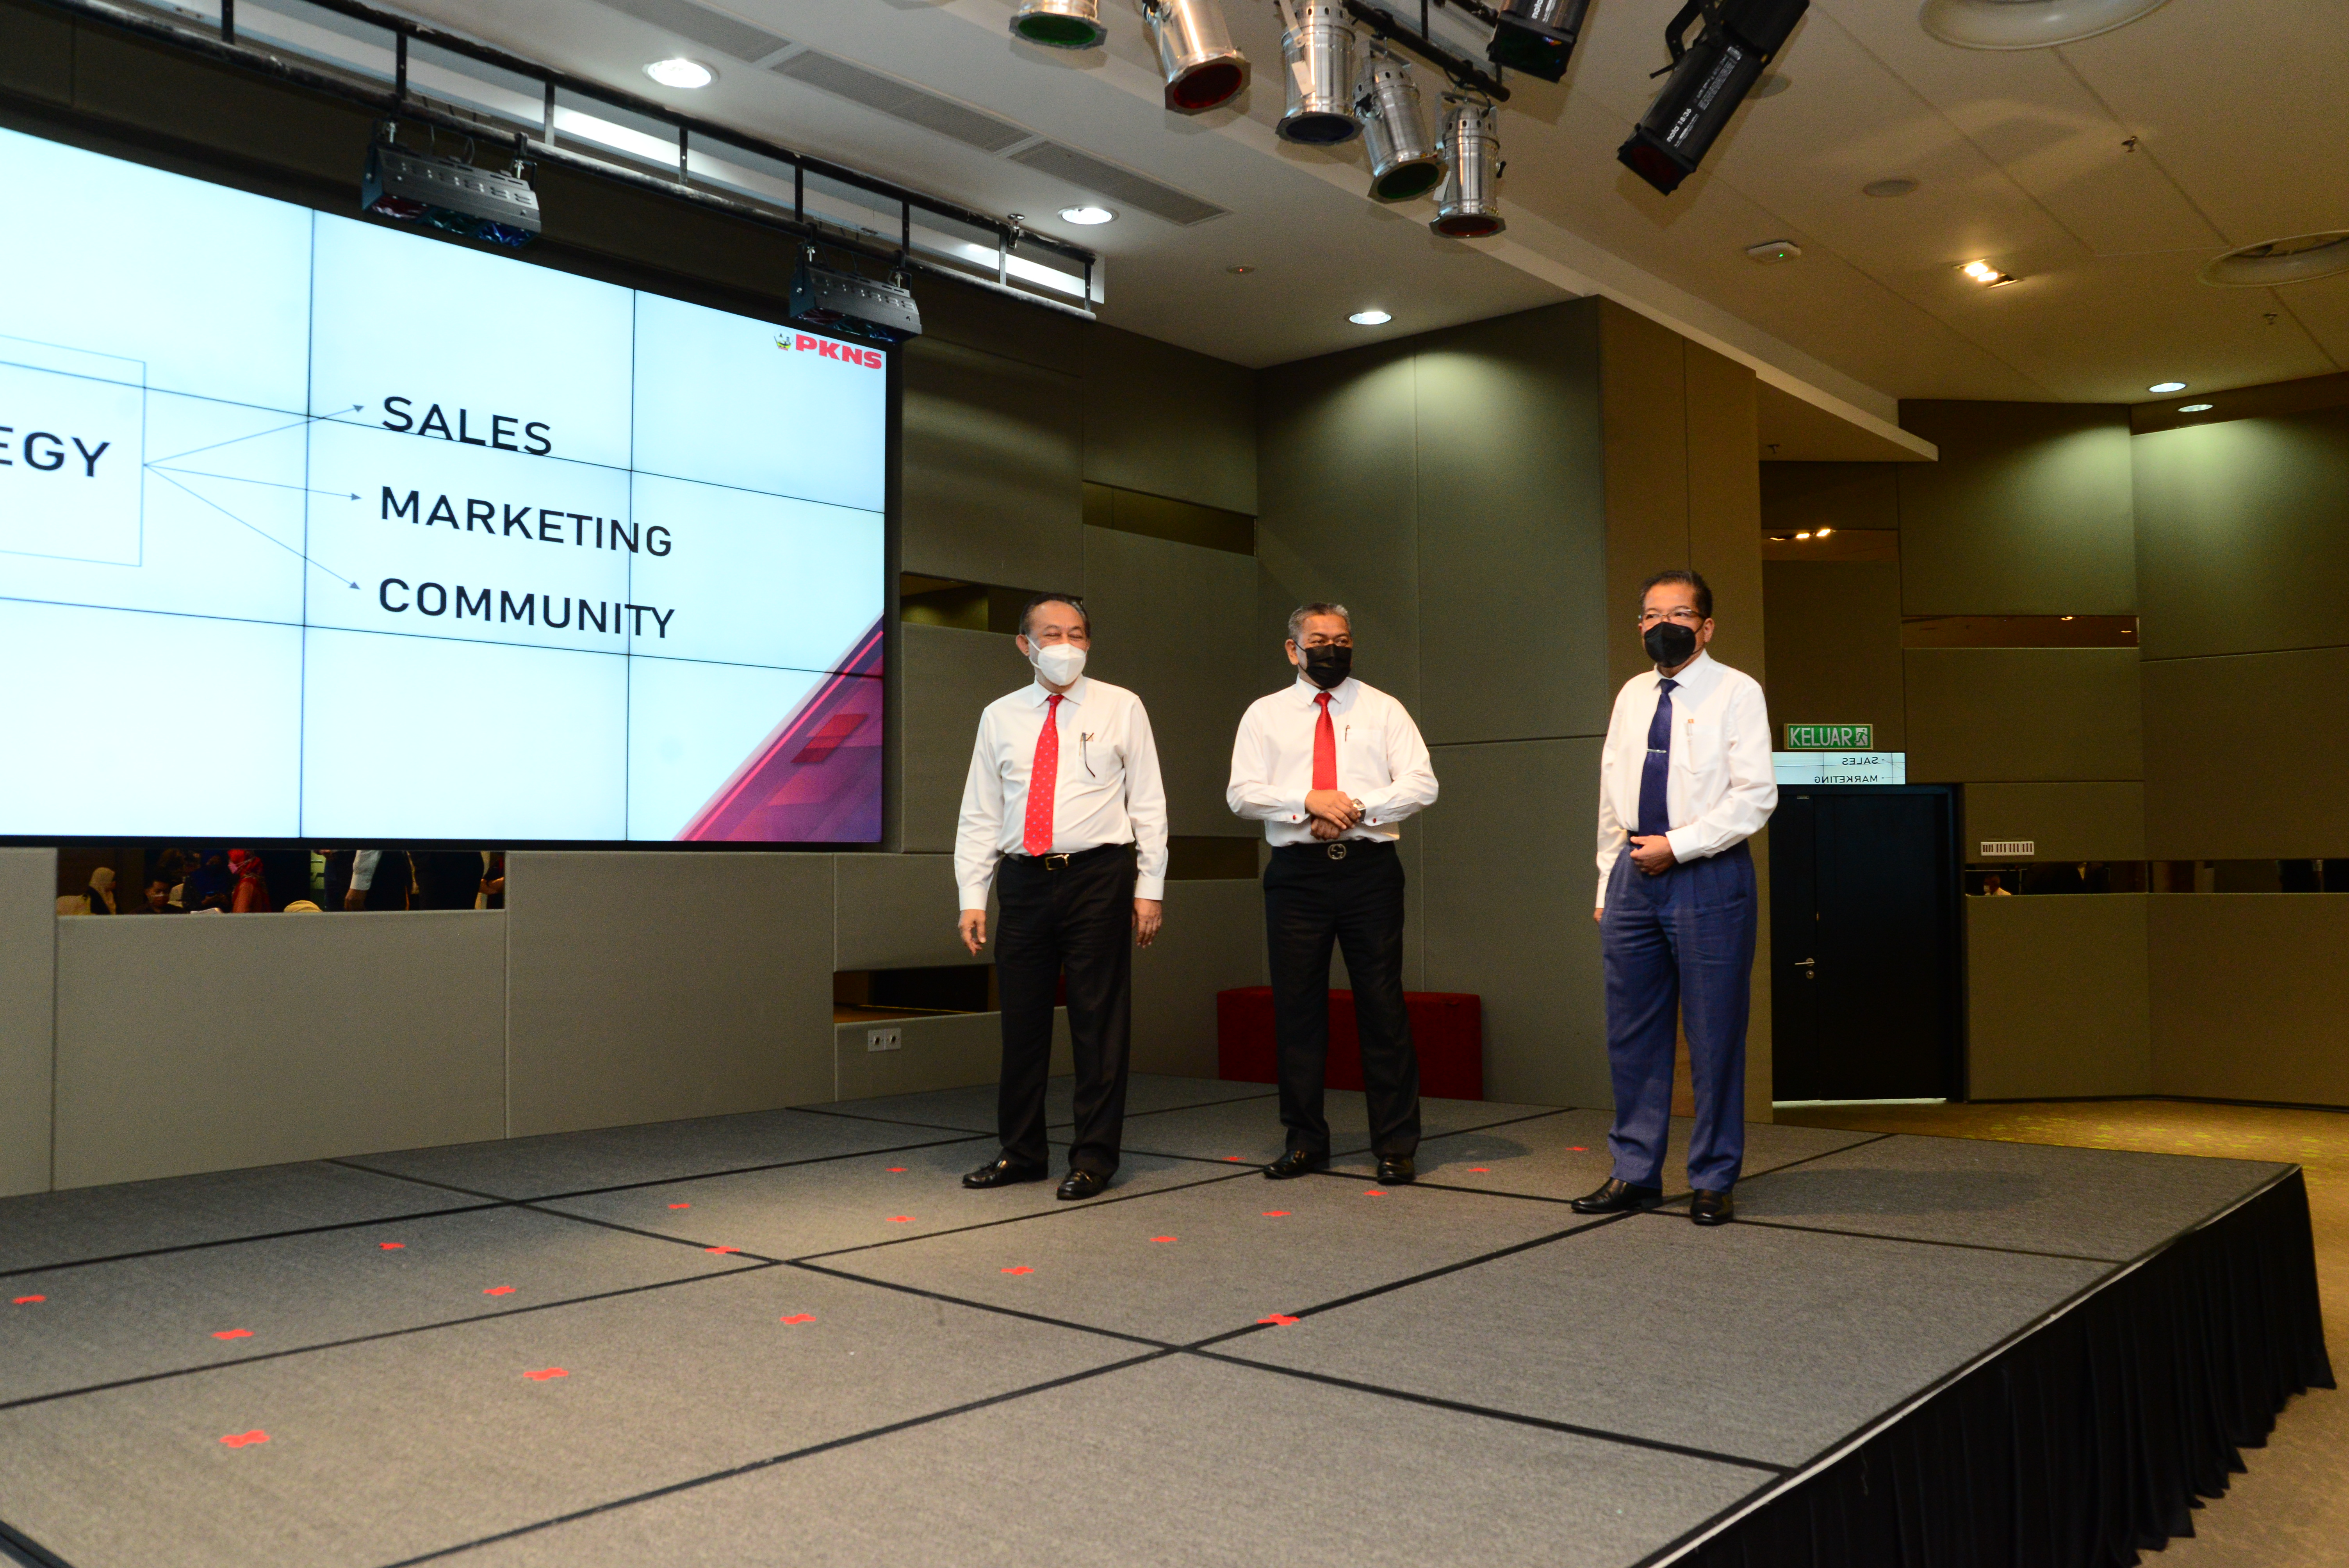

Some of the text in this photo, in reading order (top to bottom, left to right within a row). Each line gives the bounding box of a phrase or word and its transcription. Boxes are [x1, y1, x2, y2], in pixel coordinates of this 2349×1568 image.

[1666, 126, 1679, 143] nota
[796, 334, 882, 369] PKNS
[382, 396, 552, 456] SALES
[381, 486, 671, 557] MARKETING
[380, 578, 675, 639] COMMUNITY
[1790, 727, 1852, 746] KELUAR
